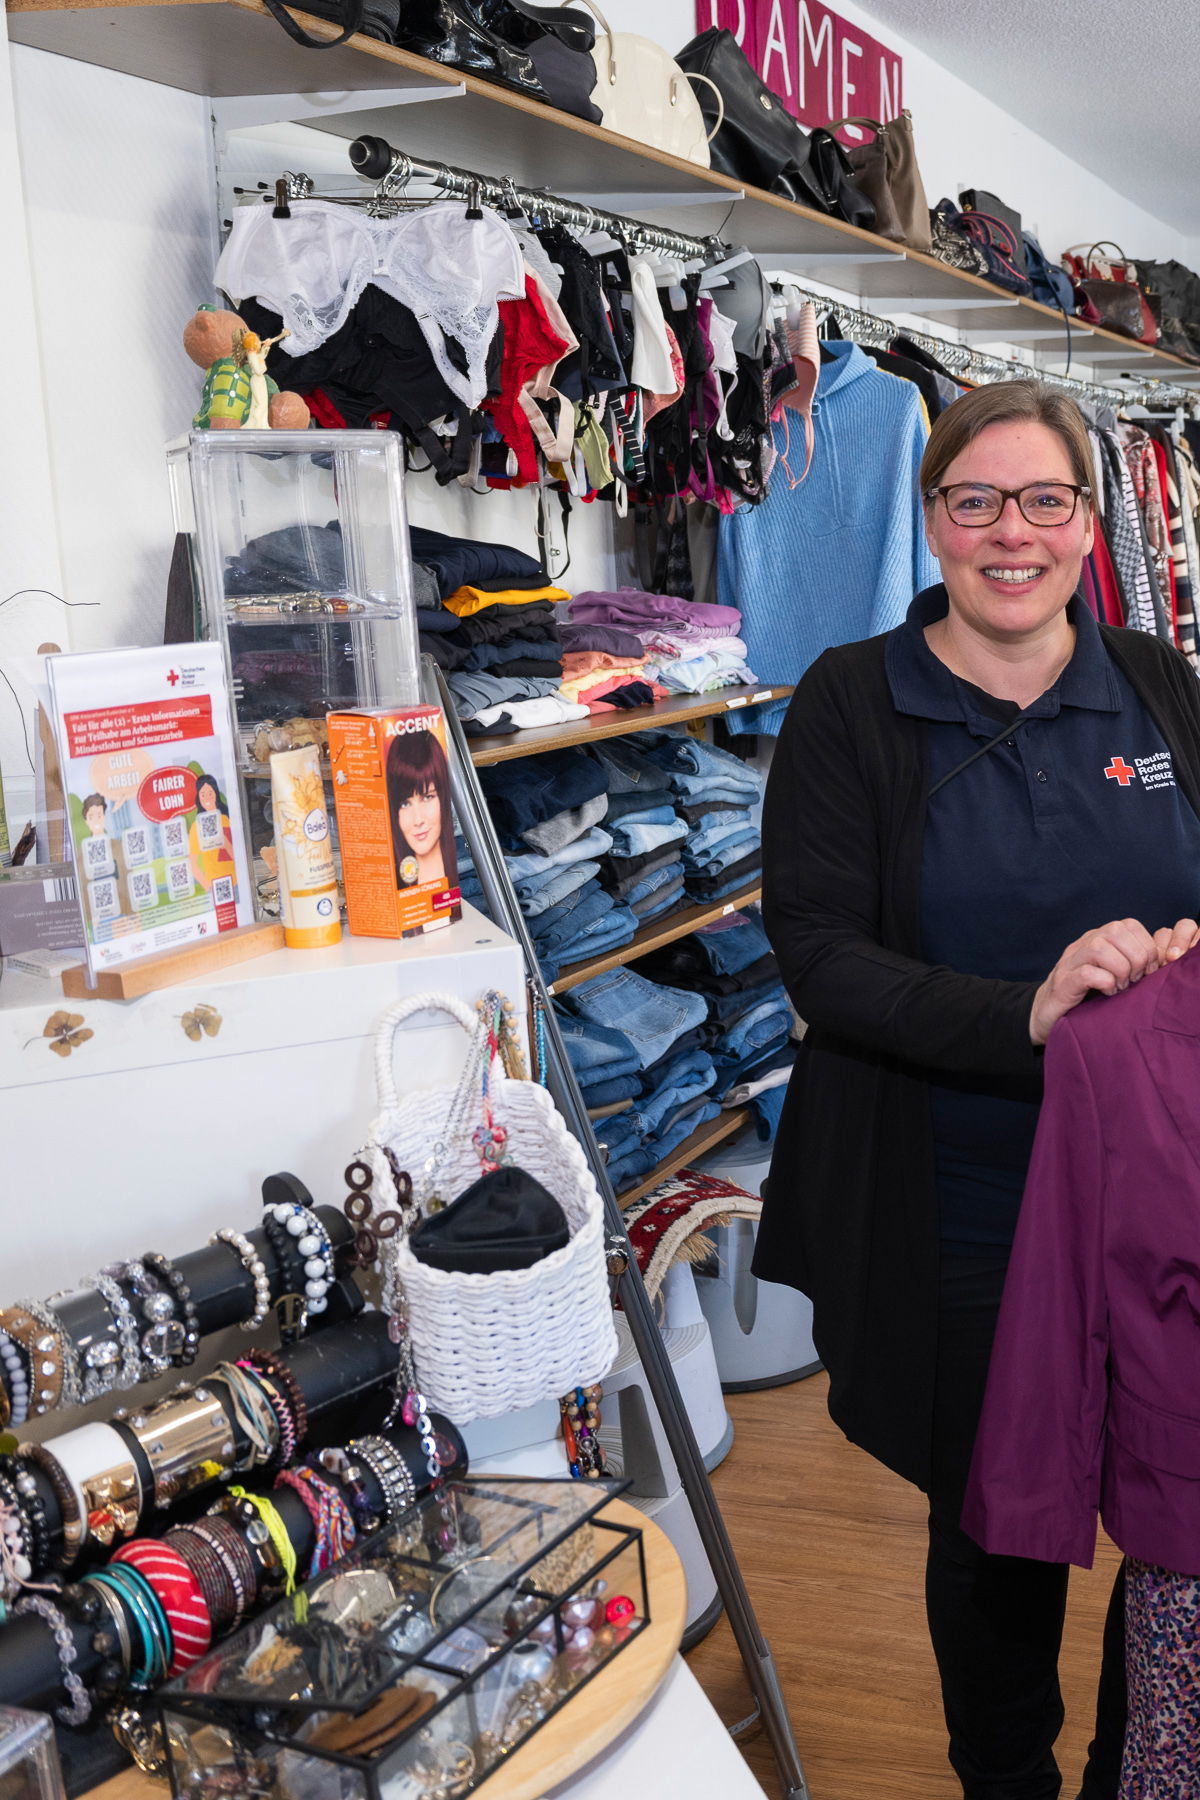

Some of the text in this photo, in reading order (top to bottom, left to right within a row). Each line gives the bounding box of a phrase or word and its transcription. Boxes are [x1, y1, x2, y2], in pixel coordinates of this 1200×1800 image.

[72, 722, 87, 733] Fair
[88, 720, 99, 731] für
[100, 718, 113, 729] alle
[132, 713, 151, 725] Erste
[151, 707, 200, 722] Informationen
[386, 715, 440, 737] ACCENT
[73, 734, 86, 744] zur
[88, 729, 118, 742] Teilhabe
[119, 728, 131, 738] am
[75, 730, 183, 755] Mindestlohn und Schwarzarbeit
[108, 753, 133, 770] GUTE
[1138, 762, 1170, 776] Rotes
[107, 771, 141, 790] ARBEIT
[152, 774, 185, 793] FAIRER
[1141, 771, 1174, 784] Kreuz
[159, 793, 184, 811] LOHN
[306, 822, 326, 834] Balea
